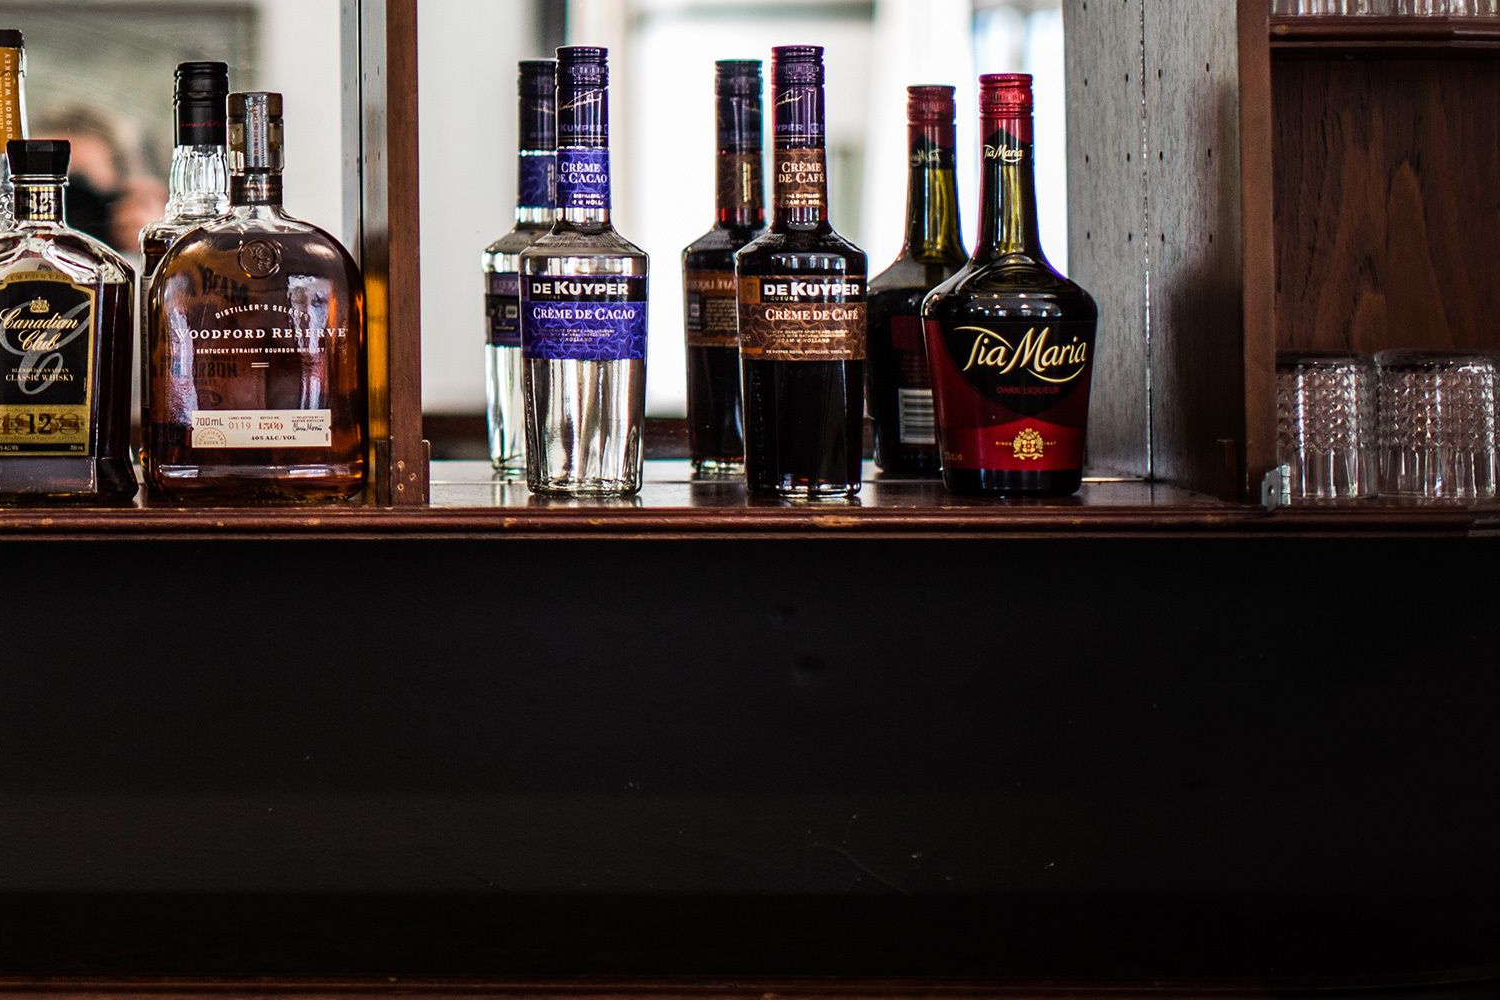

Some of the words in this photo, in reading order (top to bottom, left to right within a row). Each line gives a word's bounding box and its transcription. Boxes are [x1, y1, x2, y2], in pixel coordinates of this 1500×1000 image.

[4, 52, 12, 96] WHISKEY
[983, 144, 997, 159] Tia
[992, 144, 1024, 162] Maria
[561, 161, 600, 173] CRÈME
[782, 160, 822, 173] CRÈME
[569, 172, 608, 184] CACAO
[778, 174, 792, 183] DE
[796, 172, 824, 184] CAFÉ
[532, 283, 552, 294] DE
[554, 280, 628, 295] KUYPER
[764, 284, 788, 295] DE
[791, 282, 860, 296] KUYPER
[215, 304, 268, 319] DISTILLER'S
[533, 306, 572, 320] CRÈME
[575, 310, 592, 320] DE
[594, 308, 635, 320] CACAO
[765, 308, 810, 321] CRÈME
[813, 311, 829, 320] DE
[832, 308, 859, 321] CAFÉ
[0, 307, 78, 330] Canadian
[176, 328, 266, 340] WOODFORD
[272, 328, 346, 338] RESERVE
[952, 326, 1014, 372] Tia
[998, 326, 1087, 384] Maria
[6, 374, 39, 382] CLASSIC
[41, 374, 75, 382] WHISKY
[996, 386, 1022, 396] DARK
[1024, 386, 1060, 397] LIQUEUR
[26, 413, 52, 435] 12
[196, 417, 224, 426] 700mL
[228, 422, 251, 430] 0119
